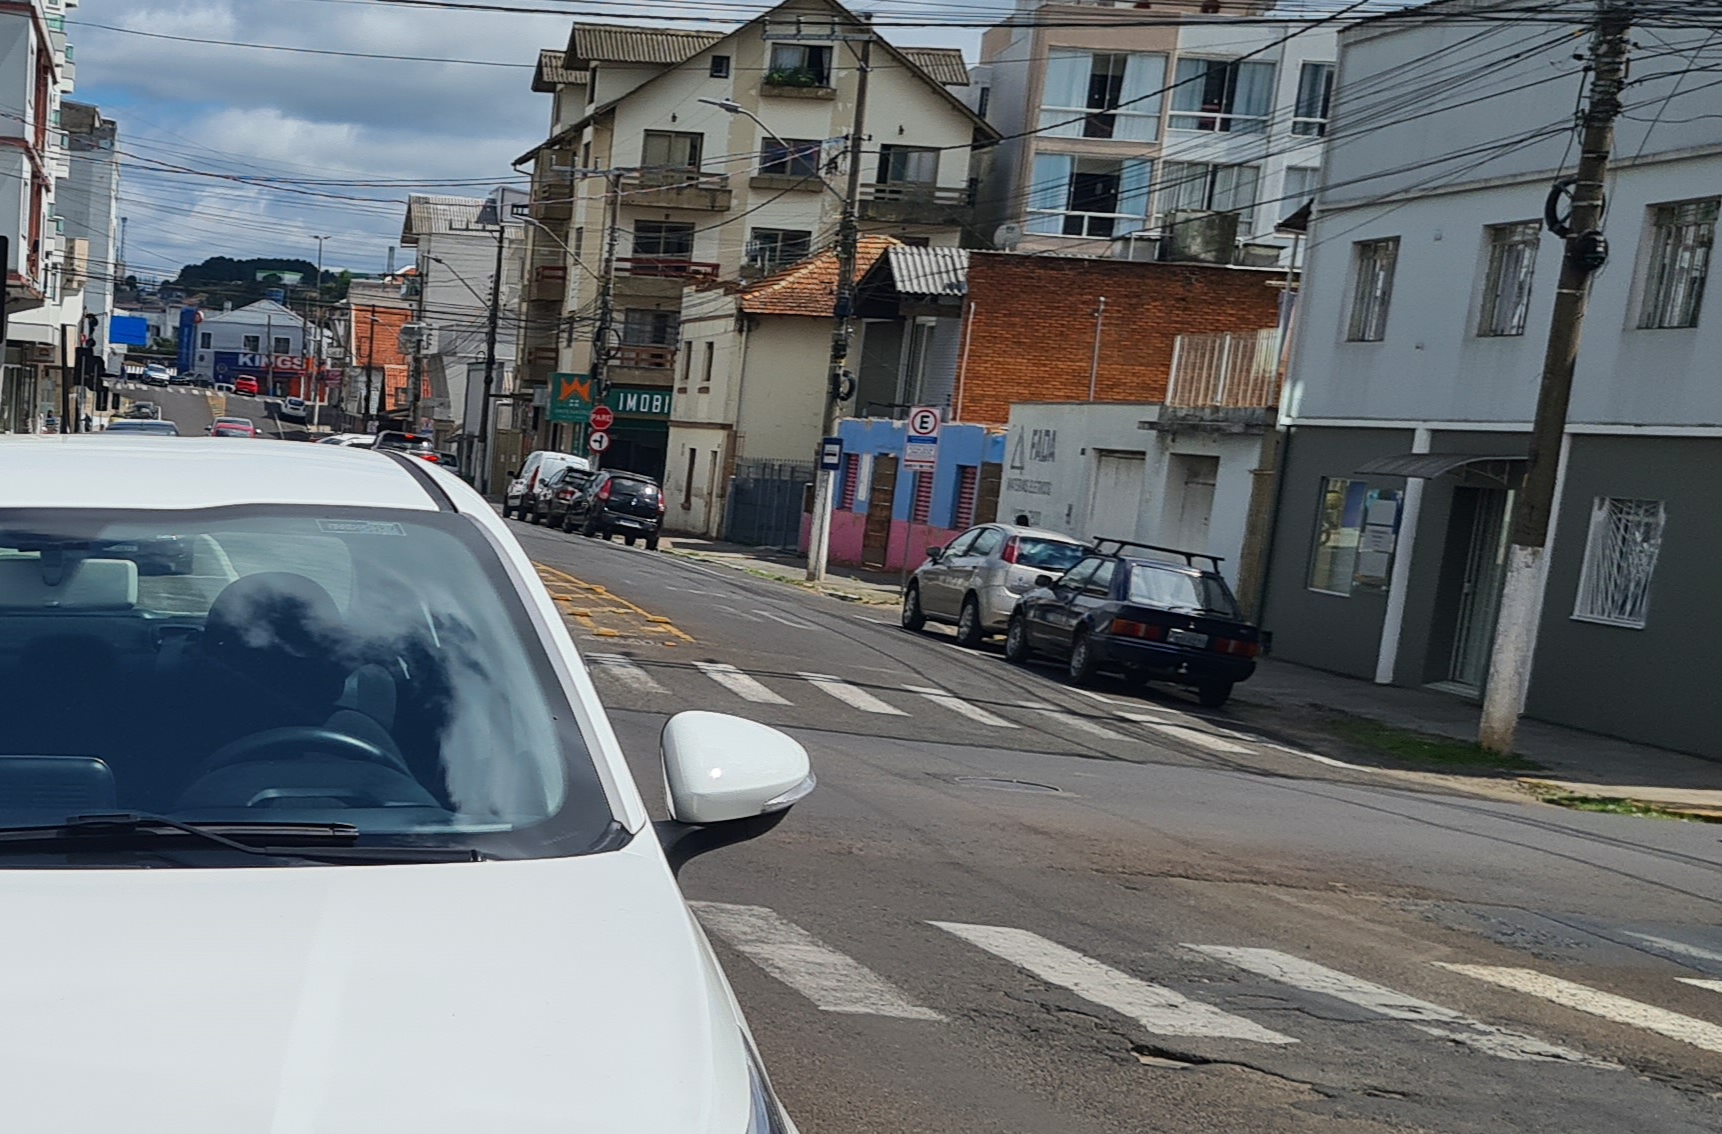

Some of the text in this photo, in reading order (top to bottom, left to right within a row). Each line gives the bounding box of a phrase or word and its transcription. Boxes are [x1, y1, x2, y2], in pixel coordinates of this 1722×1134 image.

[238, 353, 306, 370] KINGS
[618, 393, 670, 413] IMOBI
[591, 413, 613, 422] PARE
[919, 415, 931, 430] E
